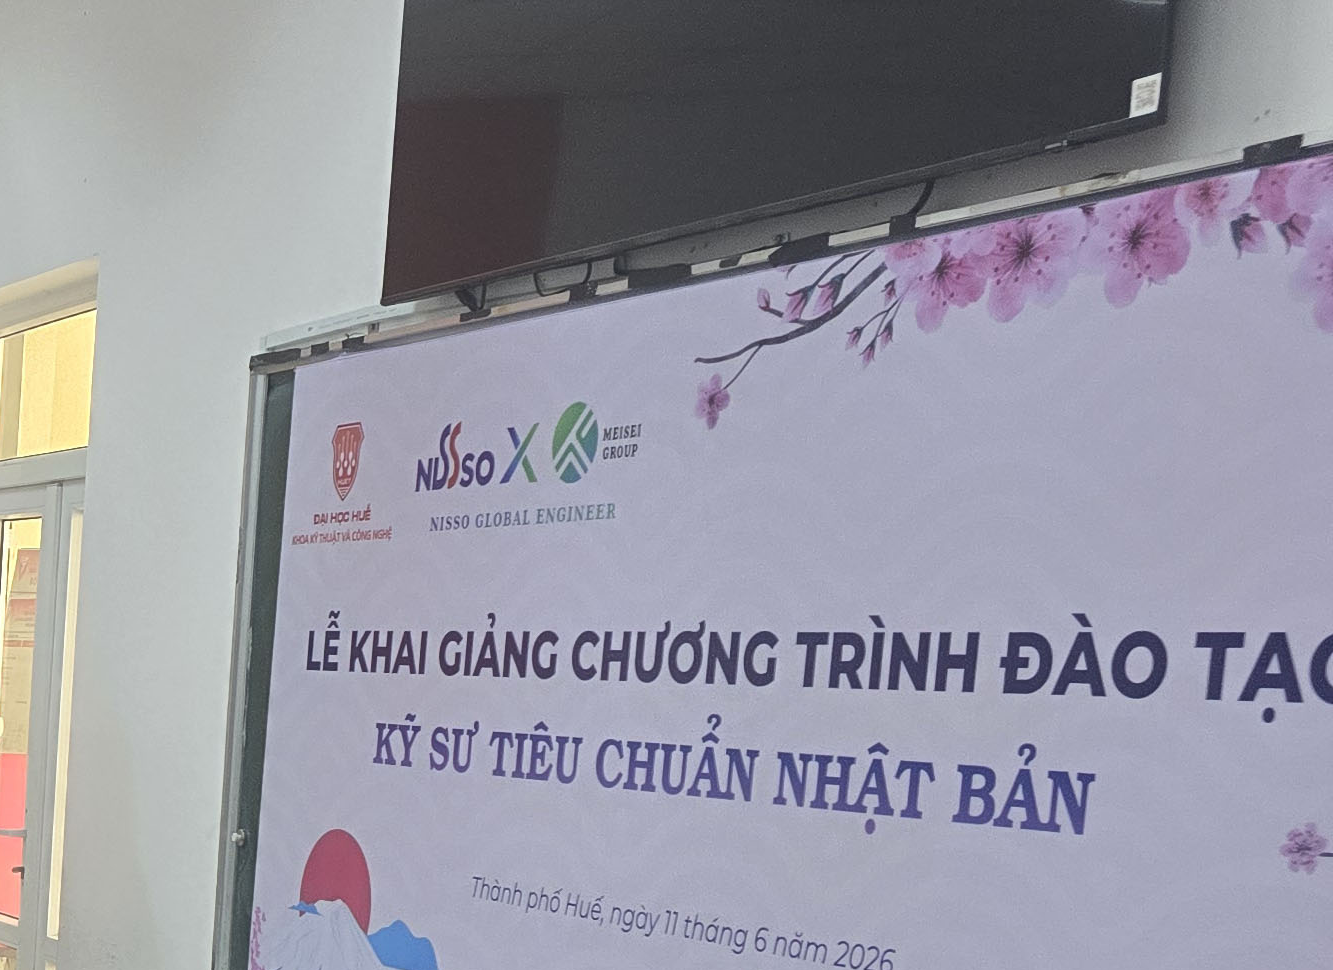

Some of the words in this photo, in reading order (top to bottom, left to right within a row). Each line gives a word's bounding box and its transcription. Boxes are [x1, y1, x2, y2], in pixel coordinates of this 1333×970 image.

[602, 423, 642, 441] MEISEI
[603, 443, 638, 460] GROUP
[330, 511, 350, 526] HỌC
[352, 503, 372, 521] HUẾ
[429, 514, 470, 532] NISSO
[475, 509, 530, 528] GLOBAL
[535, 502, 616, 525] ENGINEER
[305, 610, 341, 672] LỄ
[348, 630, 429, 675] KHAI
[438, 612, 560, 680] GIẢNG
[571, 620, 780, 688] CHƯƠNG
[795, 614, 981, 693] TRÌNH
[999, 612, 1168, 699] ĐÀO
[373, 713, 421, 768] KỸ
[429, 720, 480, 773] SƯ
[489, 720, 584, 786] TIÊU
[595, 713, 760, 802] CHUẨN
[773, 742, 936, 836] NHẬT
[951, 742, 1097, 835] BẢN
[472, 876, 523, 907] Thành
[525, 886, 563, 914] phố
[564, 892, 605, 926] Huế,
[609, 904, 661, 937] ngày
[664, 909, 679, 936] 11
[683, 914, 749, 955] tháng
[754, 927, 770, 953] 6
[772, 931, 829, 965] năm
